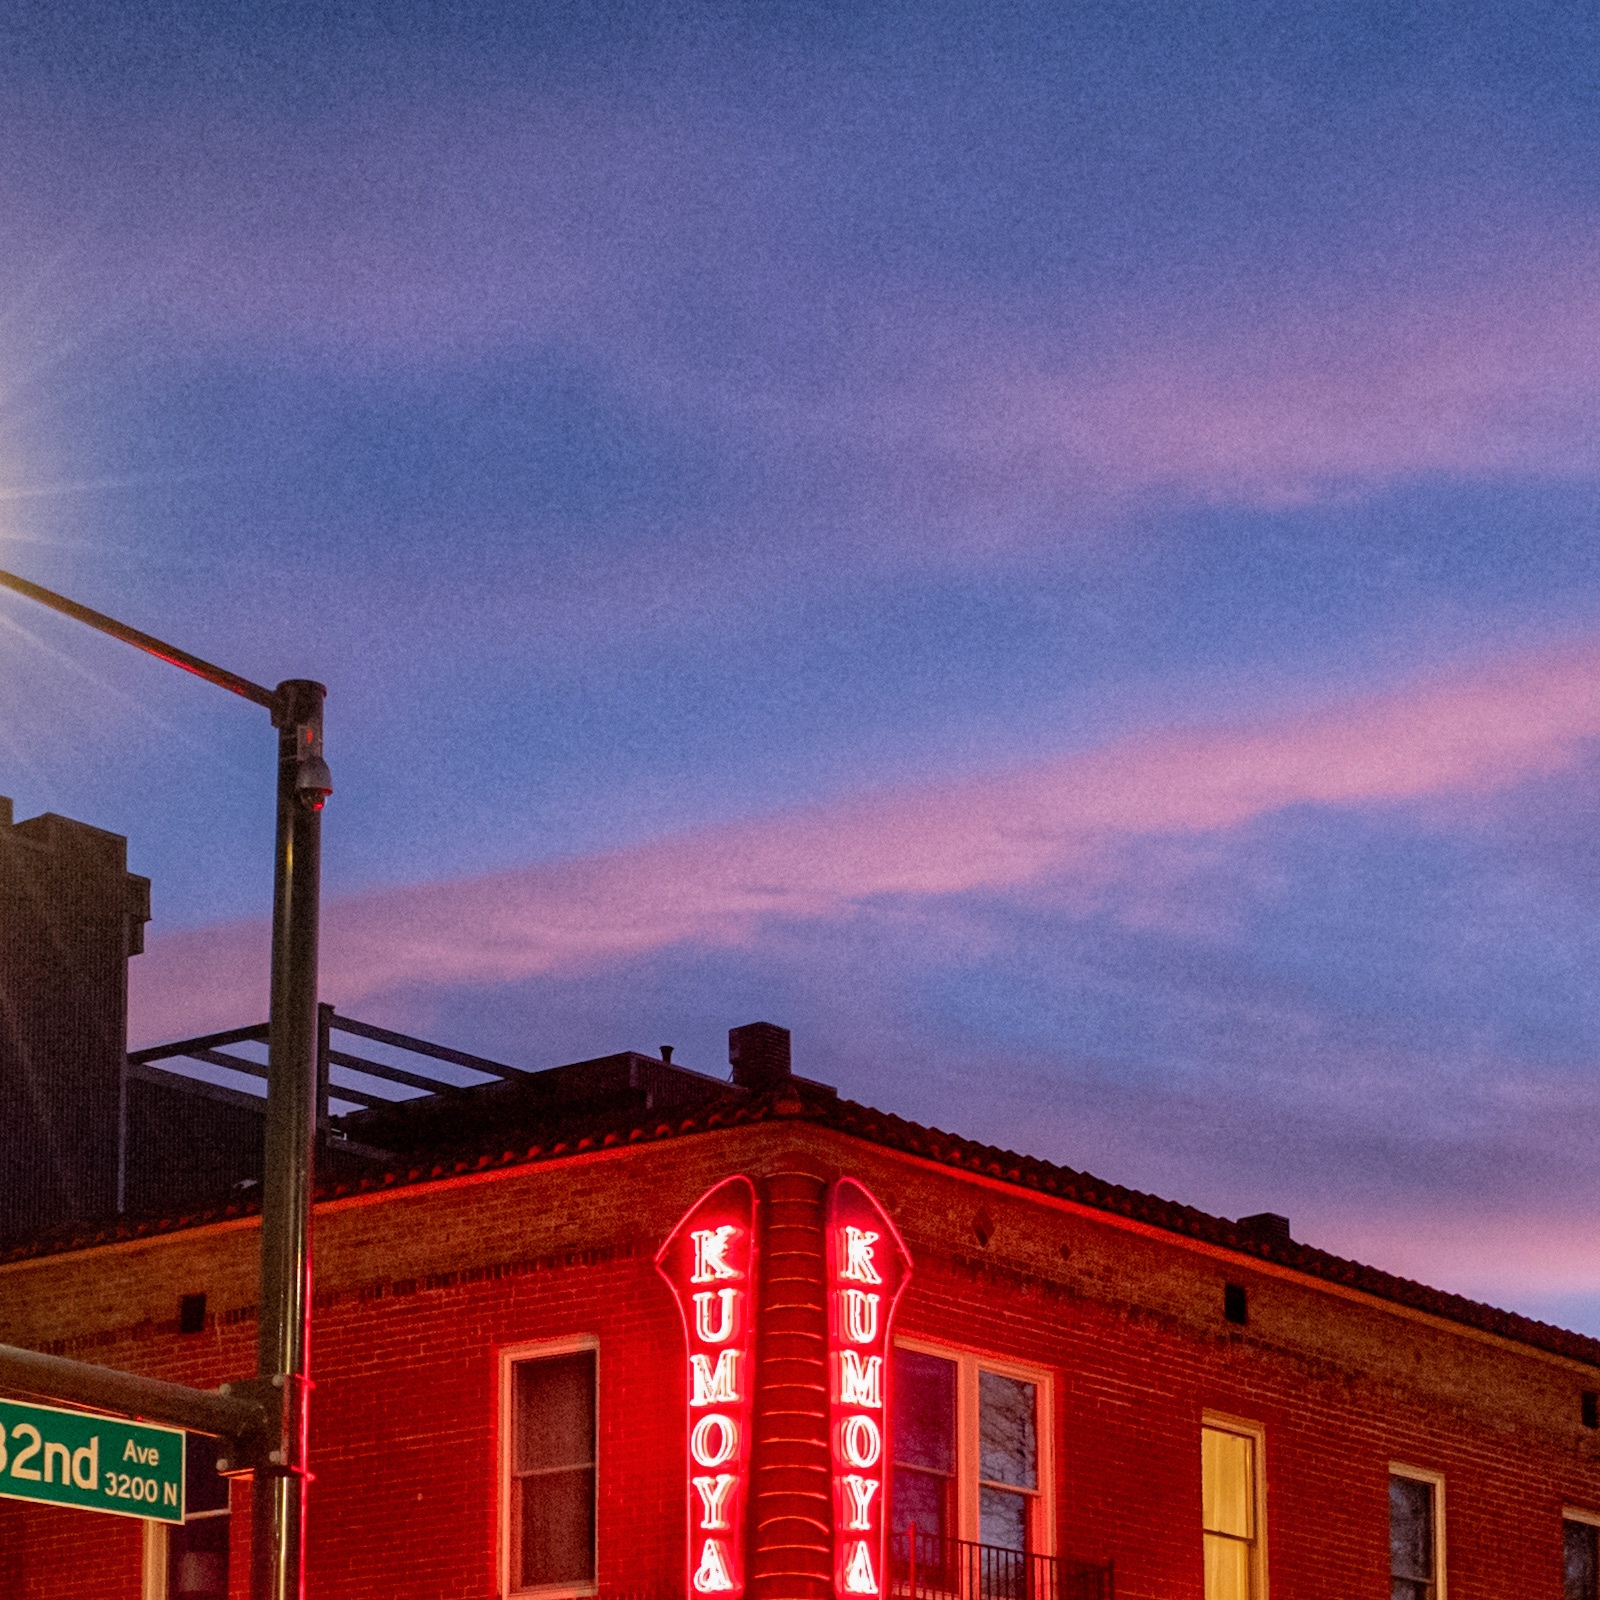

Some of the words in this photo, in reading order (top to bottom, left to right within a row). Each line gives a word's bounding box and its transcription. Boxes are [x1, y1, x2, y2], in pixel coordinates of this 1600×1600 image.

[104, 1471, 158, 1503] 3200
[163, 1481, 178, 1507] N
[122, 1439, 160, 1467] Ave
[689, 1224, 741, 1595] KUMOYA
[843, 1225, 883, 1596] KUMOYA
